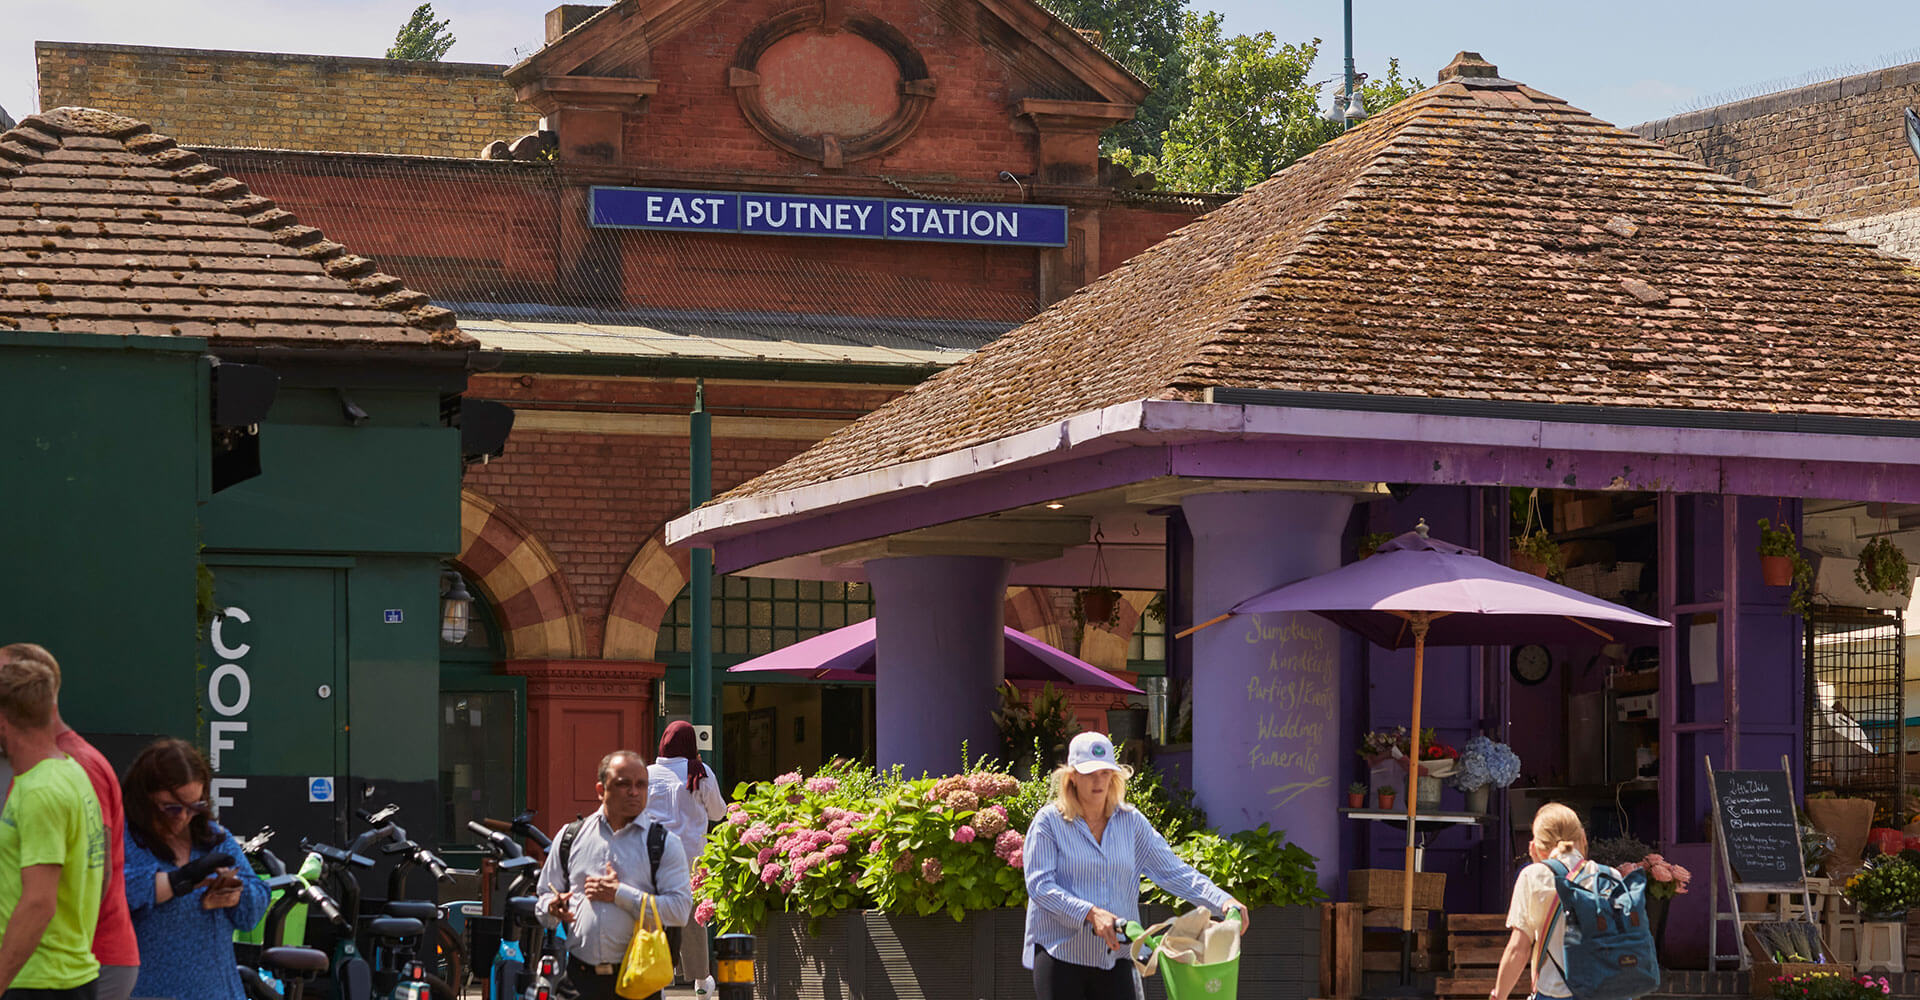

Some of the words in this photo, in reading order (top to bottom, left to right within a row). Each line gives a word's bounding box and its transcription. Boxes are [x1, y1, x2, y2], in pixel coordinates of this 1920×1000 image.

[646, 196, 724, 226] EAST
[746, 201, 872, 232] PUTNEY
[890, 206, 1019, 237] STATION
[208, 606, 250, 850] COFF
[1257, 712, 1324, 744] Weddings
[1249, 743, 1319, 775] Funerals
